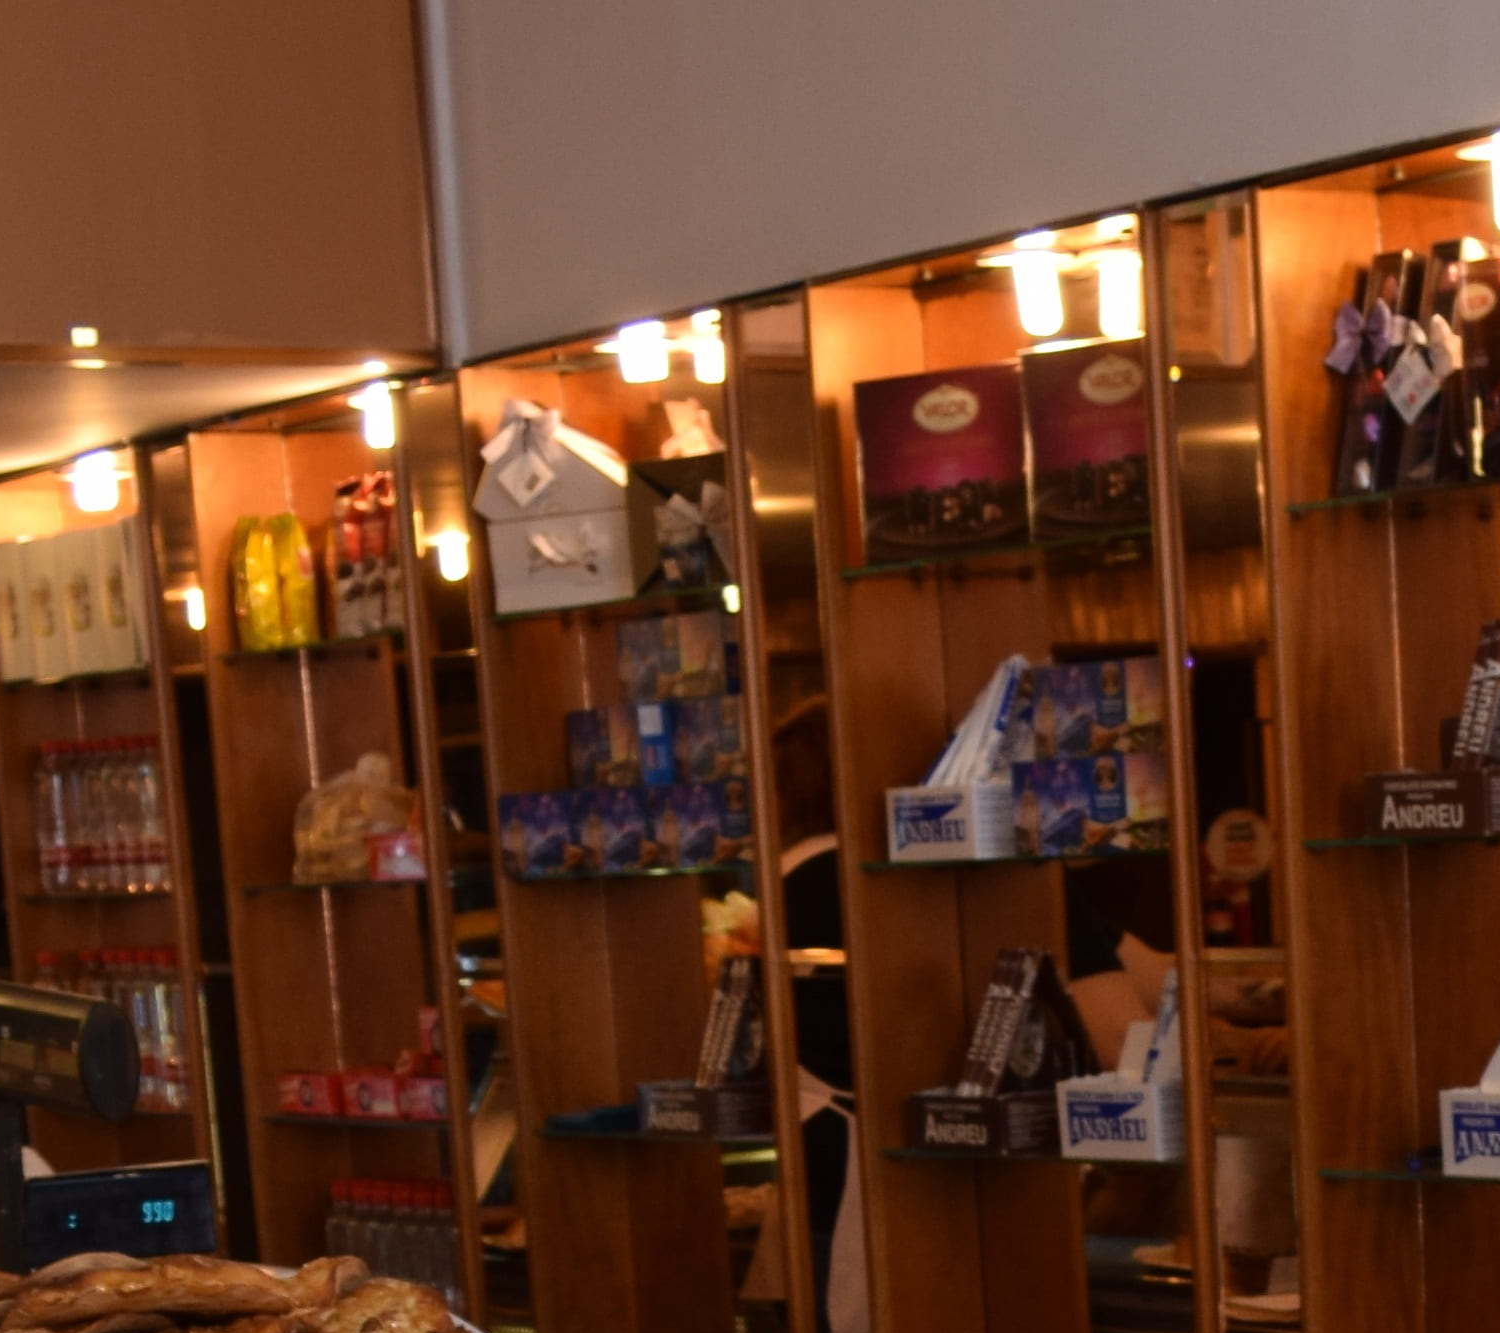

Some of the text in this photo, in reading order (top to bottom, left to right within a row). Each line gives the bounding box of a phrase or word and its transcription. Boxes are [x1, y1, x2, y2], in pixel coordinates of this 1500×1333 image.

[1382, 794, 1464, 830] ANDREU
[924, 1112, 988, 1146] ANDREU
[1069, 1116, 1147, 1143] ANDREU
